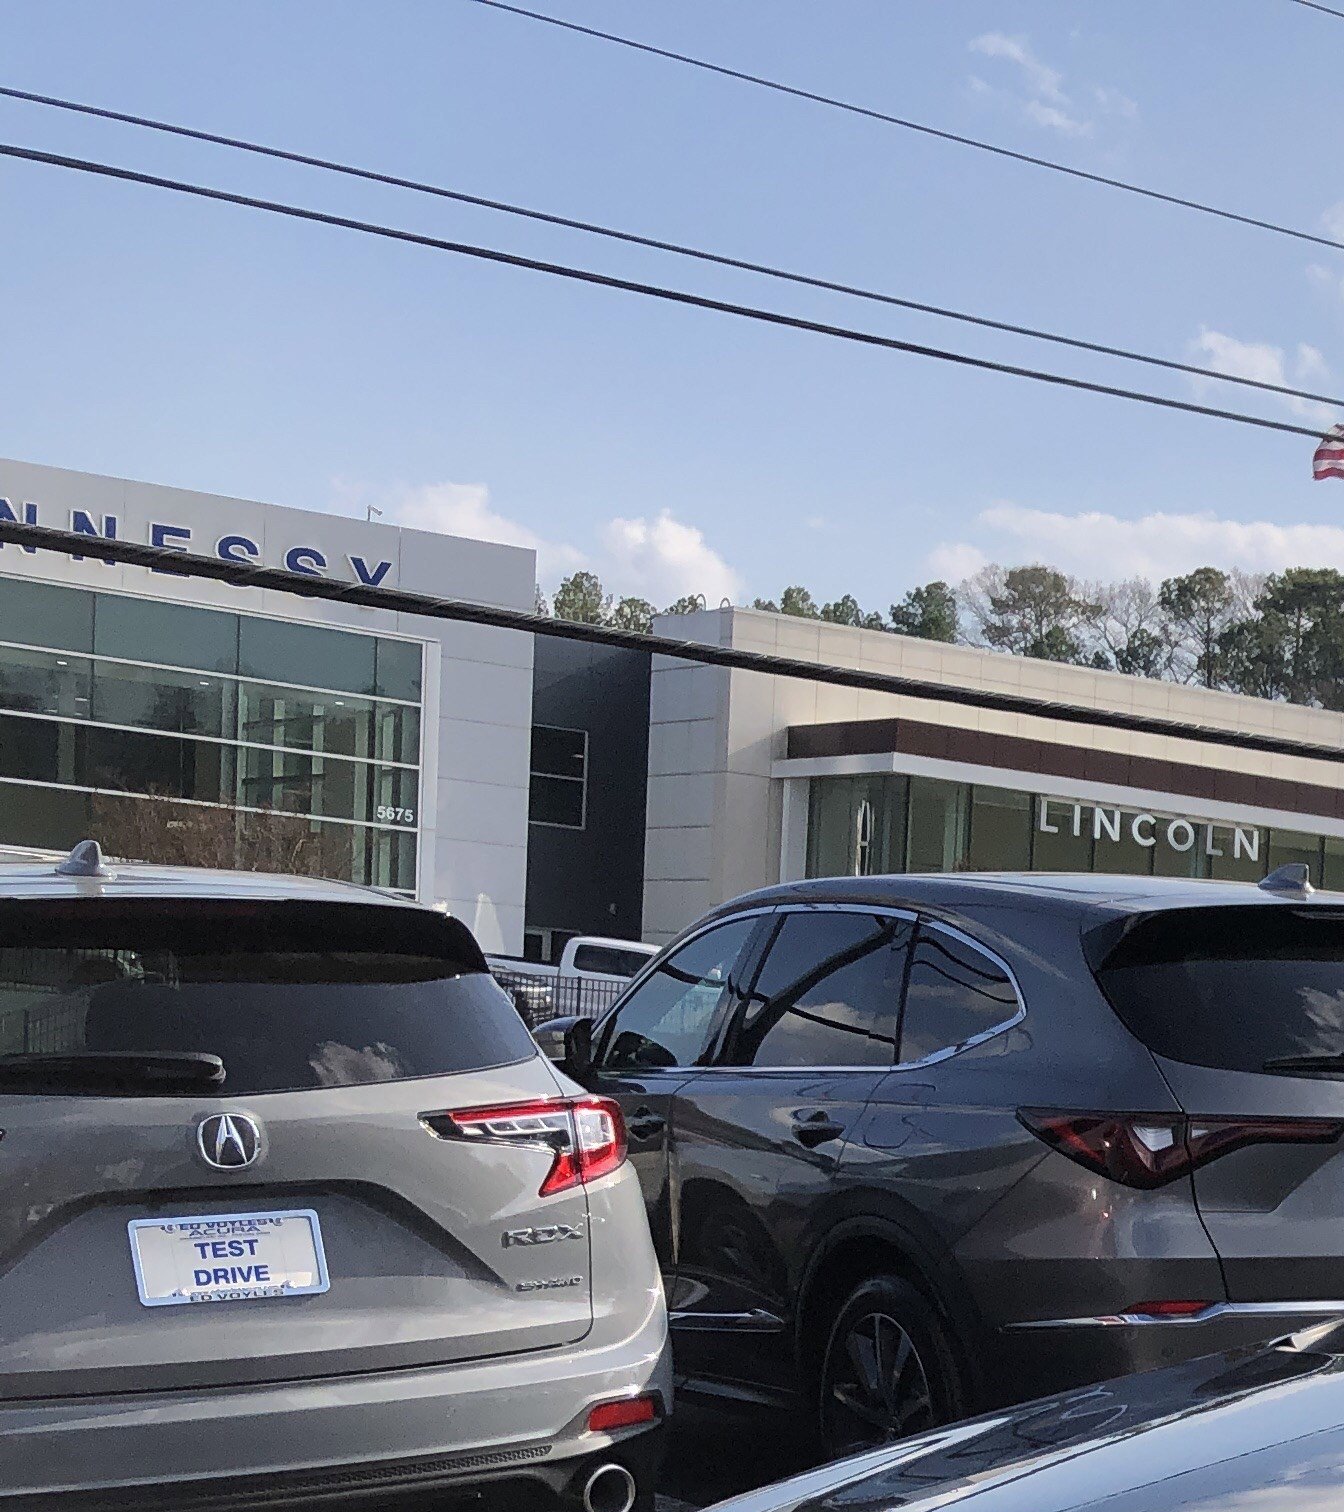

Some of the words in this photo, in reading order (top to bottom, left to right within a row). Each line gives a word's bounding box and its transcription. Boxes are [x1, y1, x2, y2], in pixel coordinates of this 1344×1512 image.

[377, 805, 414, 822] 5675
[1040, 798, 1259, 862] LINCOLN
[189, 1226, 261, 1237] ACURA
[501, 1223, 584, 1249] RDX
[194, 1239, 259, 1259] TEST
[194, 1265, 270, 1286] DRIVE
